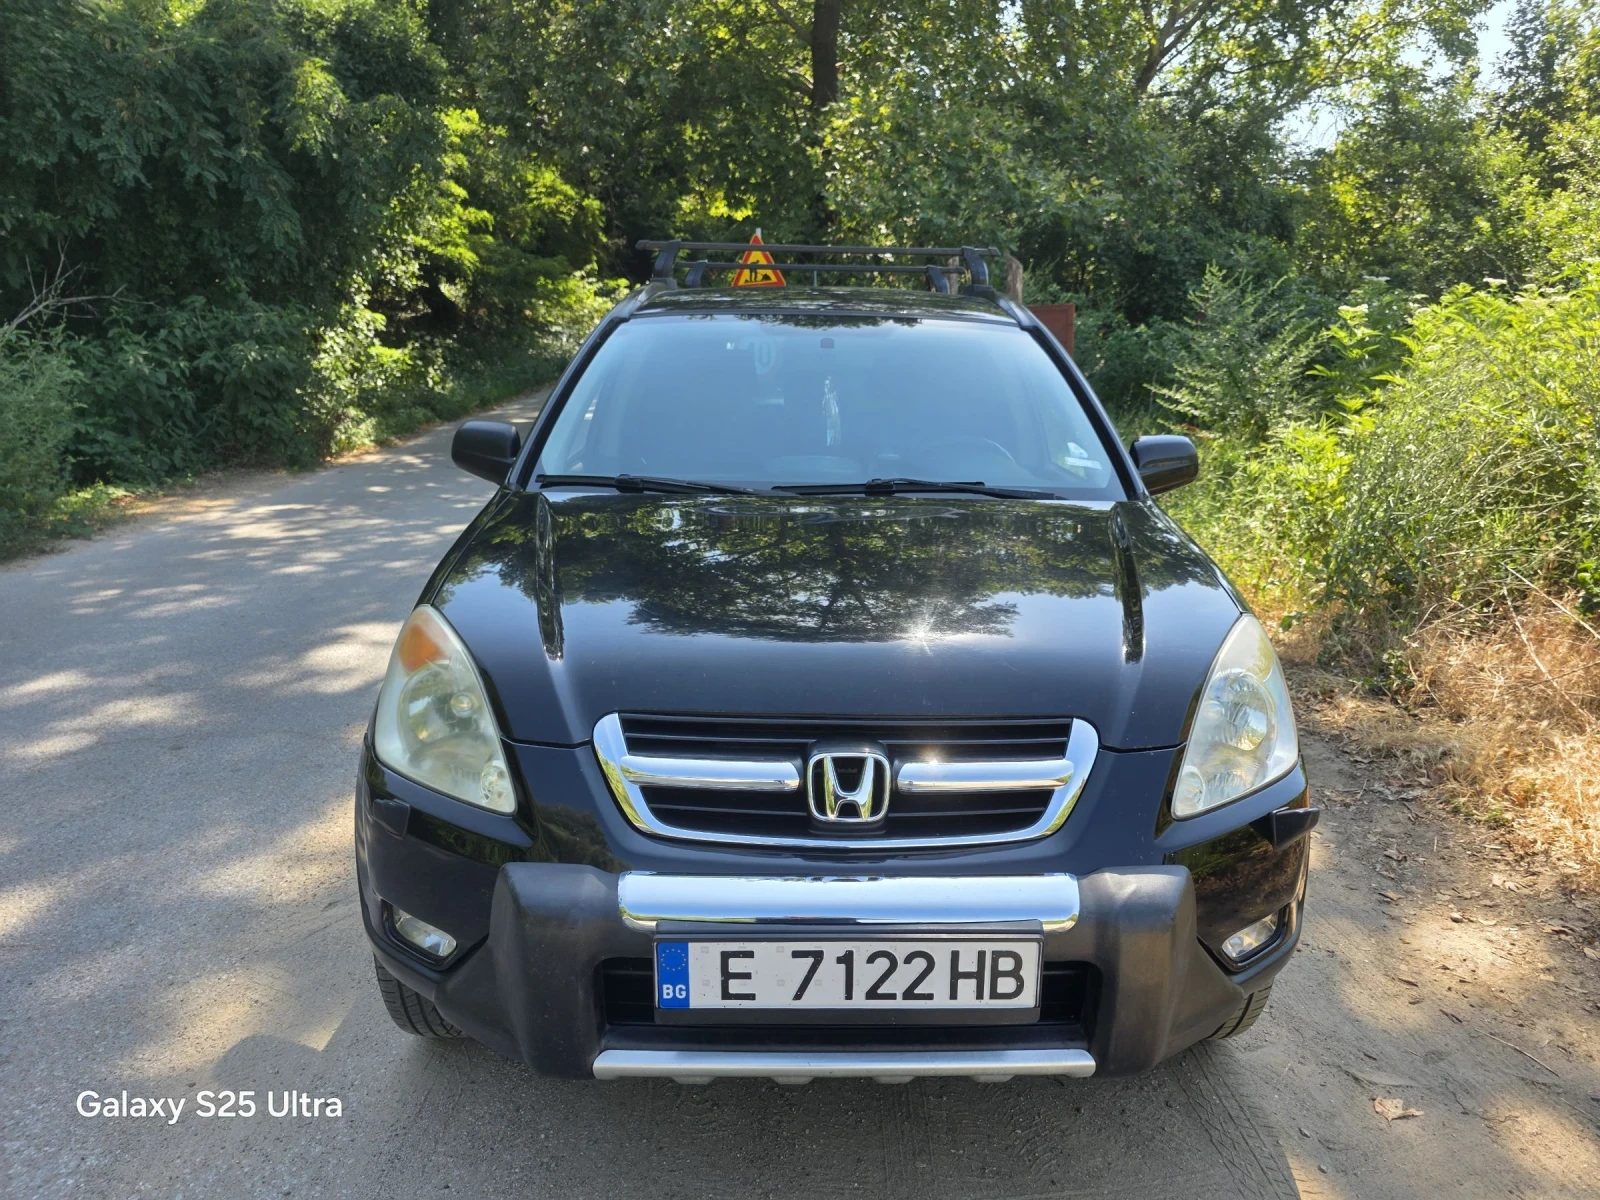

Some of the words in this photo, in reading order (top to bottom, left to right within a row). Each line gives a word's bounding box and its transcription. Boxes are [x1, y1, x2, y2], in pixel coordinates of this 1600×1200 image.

[662, 984, 687, 999] BG
[721, 950, 756, 1001] E
[791, 950, 935, 1000] 7122
[949, 950, 1025, 1000] HB
